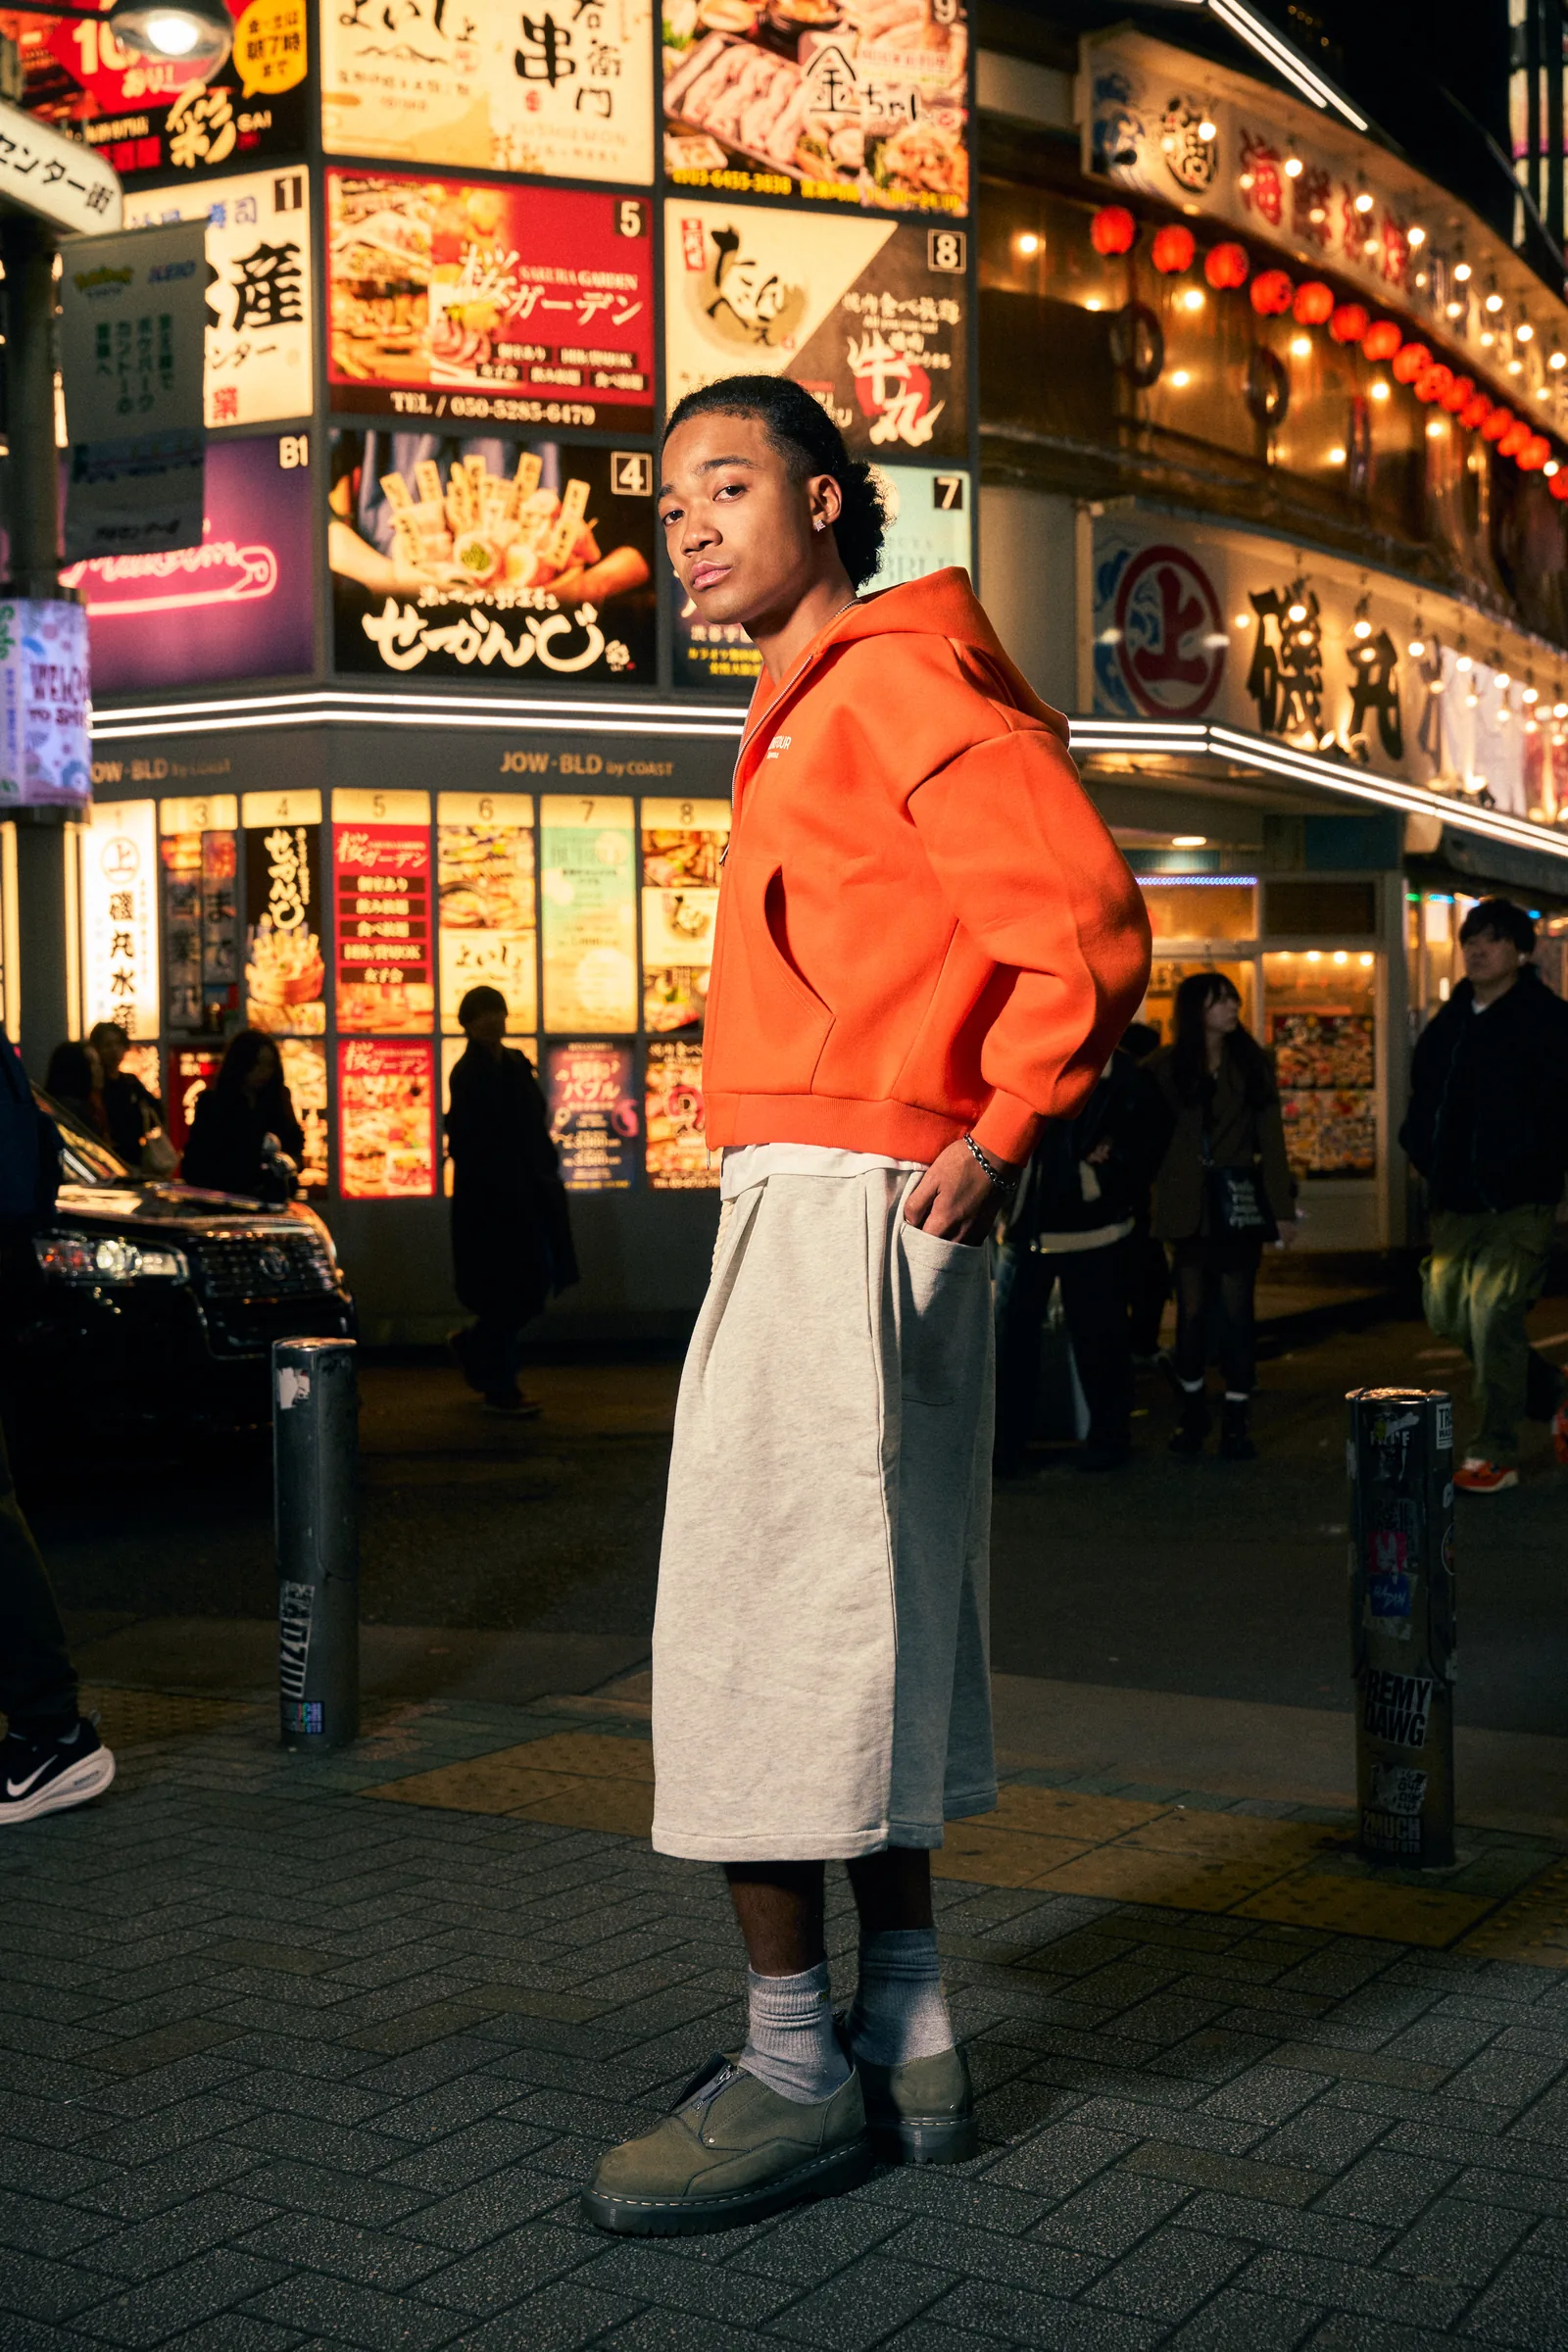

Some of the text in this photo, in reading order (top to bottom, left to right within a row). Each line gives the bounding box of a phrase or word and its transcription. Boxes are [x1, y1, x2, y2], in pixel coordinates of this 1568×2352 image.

[166, 80, 237, 169] 彩
[237, 109, 272, 131] SAI
[0, 134, 115, 215] センター街
[619, 201, 642, 237] 5
[936, 234, 958, 269] 8
[459, 242, 644, 326] 桜ガーデン
[279, 434, 309, 469] B1
[619, 458, 644, 491] 4
[938, 476, 959, 510] 7
[193, 804, 209, 825] 3
[372, 794, 386, 819] 5
[478, 797, 494, 821] 6
[579, 800, 596, 823] 7
[680, 801, 694, 825] 8
[1367, 1668, 1431, 1715] REMY
[1363, 1704, 1426, 1748] DAWG
